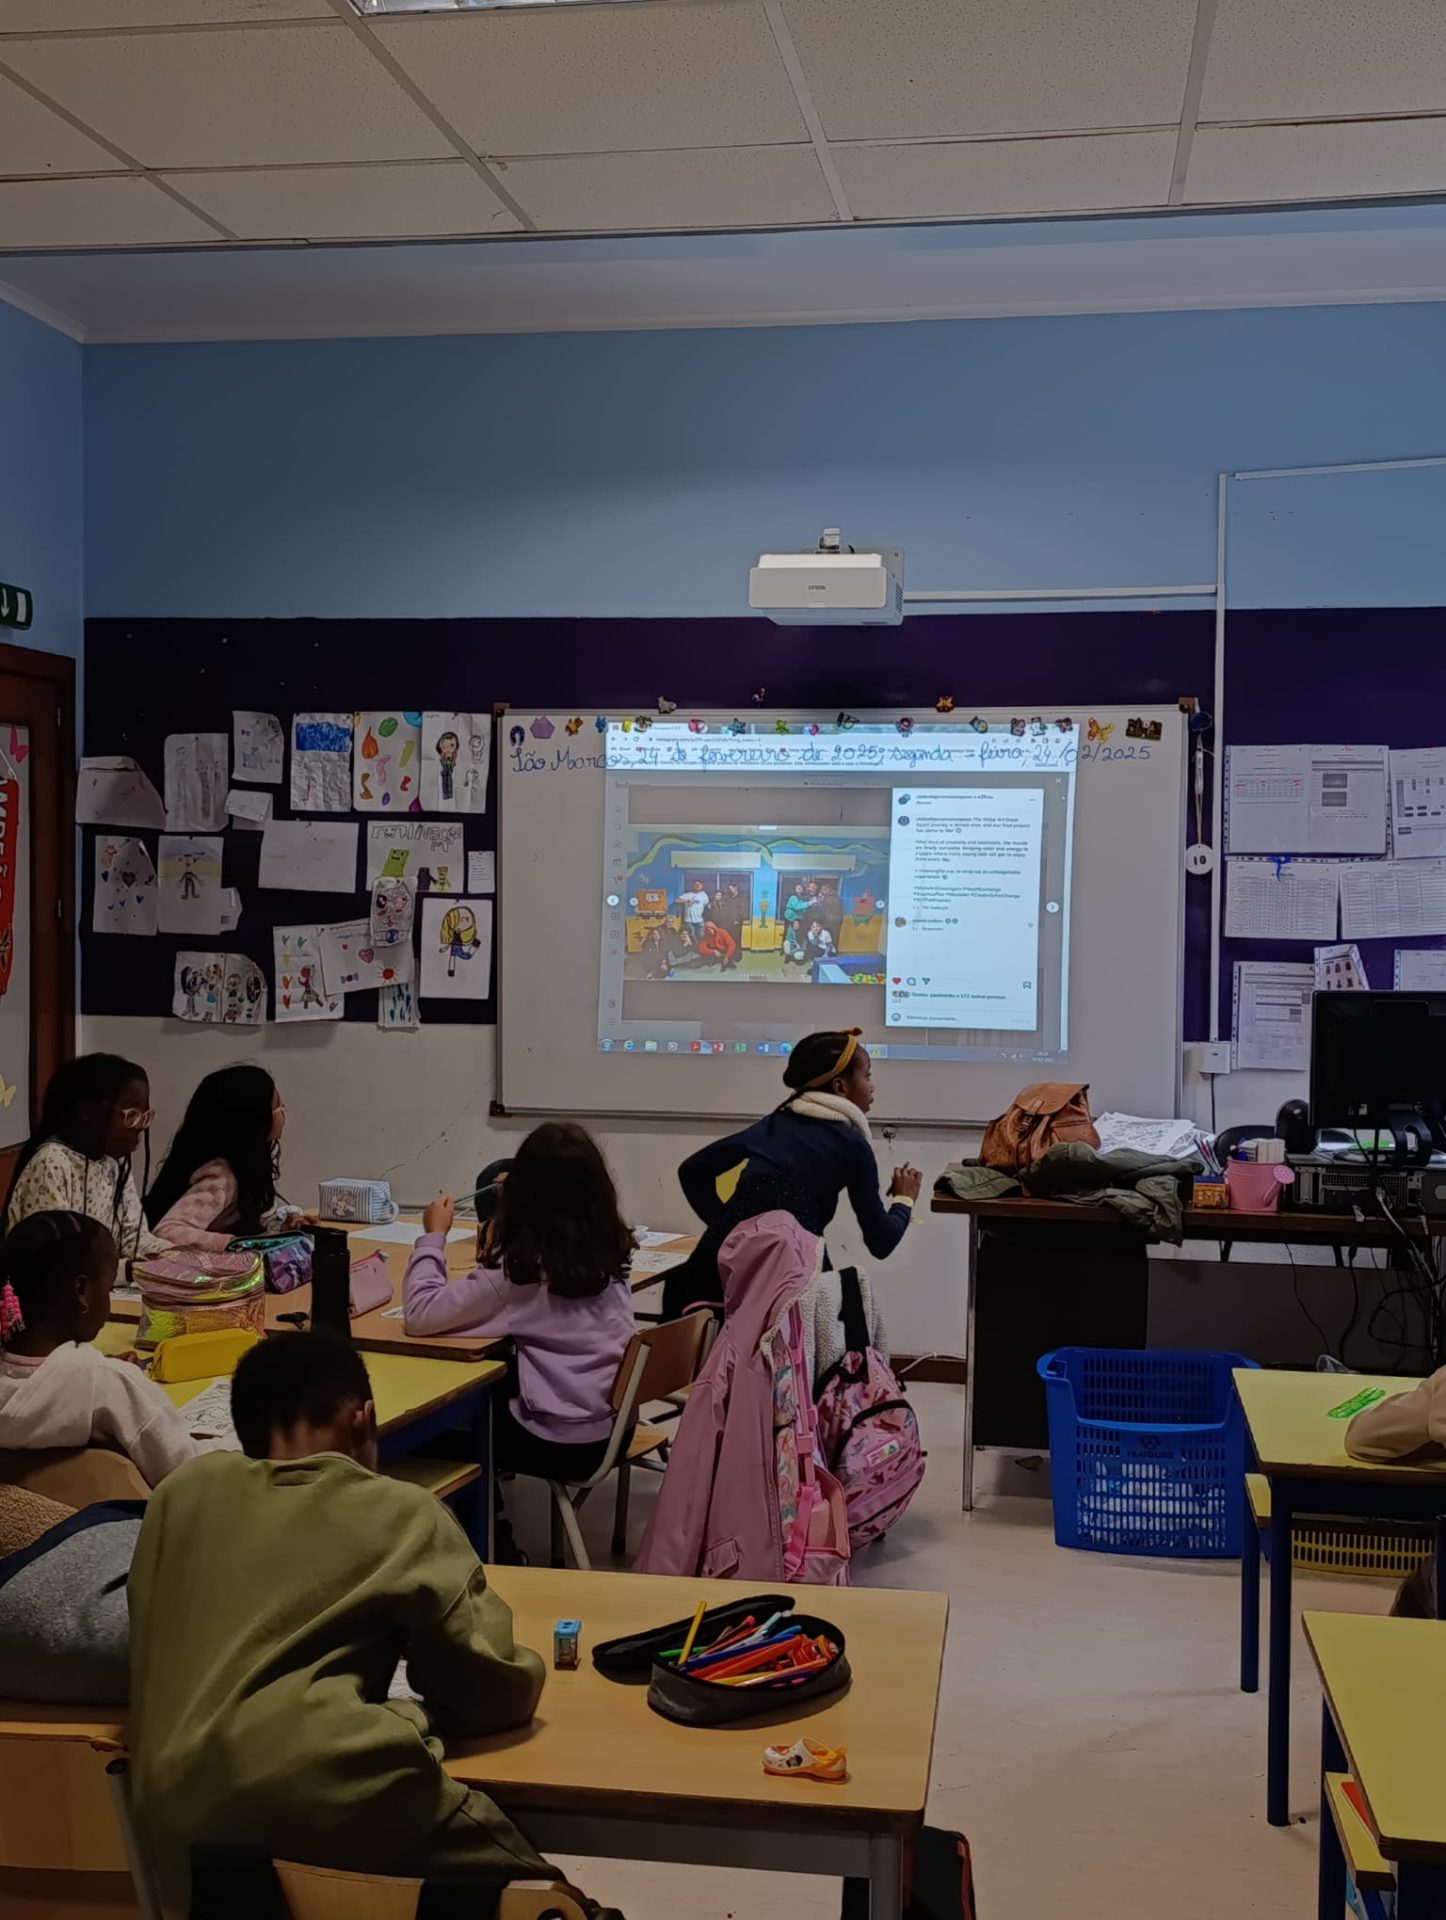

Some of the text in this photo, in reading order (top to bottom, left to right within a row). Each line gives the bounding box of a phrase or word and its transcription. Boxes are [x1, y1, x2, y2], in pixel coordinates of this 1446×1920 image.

[510, 747, 546, 773] São
[638, 747, 659, 767] 24
[670, 741, 688, 763] de
[799, 741, 824, 761] de
[1193, 855, 1207, 866] 10
